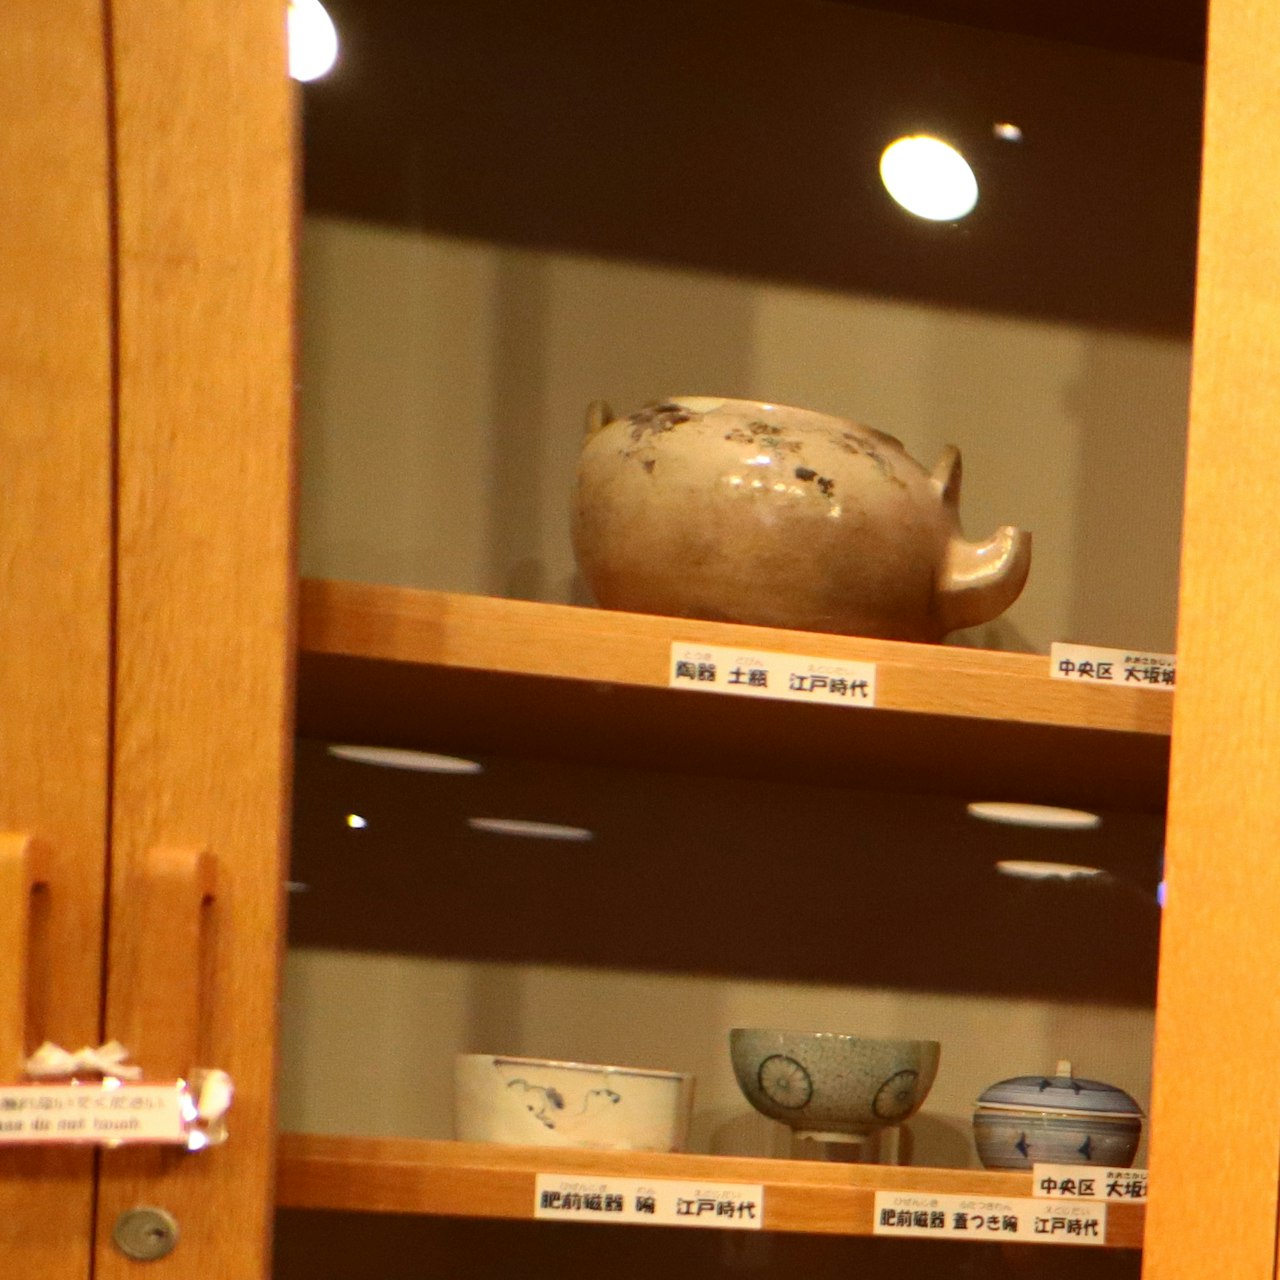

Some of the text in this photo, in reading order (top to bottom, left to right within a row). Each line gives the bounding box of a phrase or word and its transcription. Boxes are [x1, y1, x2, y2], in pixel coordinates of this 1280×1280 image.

[1058, 658, 1115, 679] 中央区
[789, 672, 869, 699] 江戸時代
[1040, 1178, 1148, 1198] 中央区 大坂
[540, 1190, 623, 1212] 肥前磁器
[677, 1198, 756, 1219] 江戸時代
[880, 1208, 945, 1229] 肥前磁器
[1034, 1216, 1099, 1237] 江戸時代
